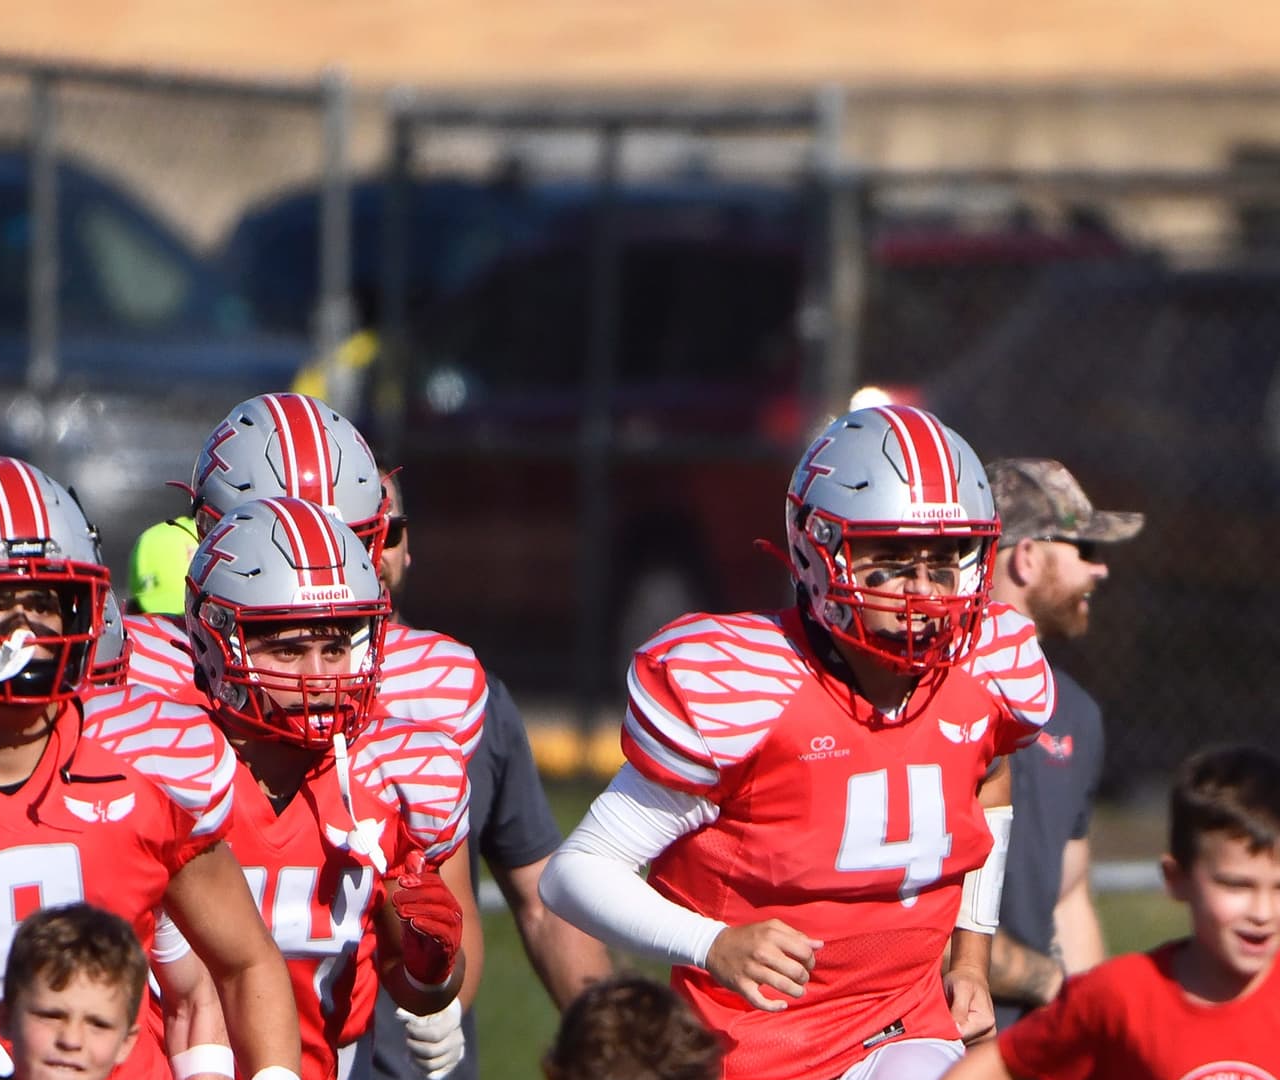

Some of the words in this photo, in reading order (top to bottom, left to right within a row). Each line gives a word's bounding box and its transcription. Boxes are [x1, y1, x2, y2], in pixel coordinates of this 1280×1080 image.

[301, 588, 349, 601] Riddell
[797, 749, 851, 762] WOOTER
[834, 763, 953, 908] 4
